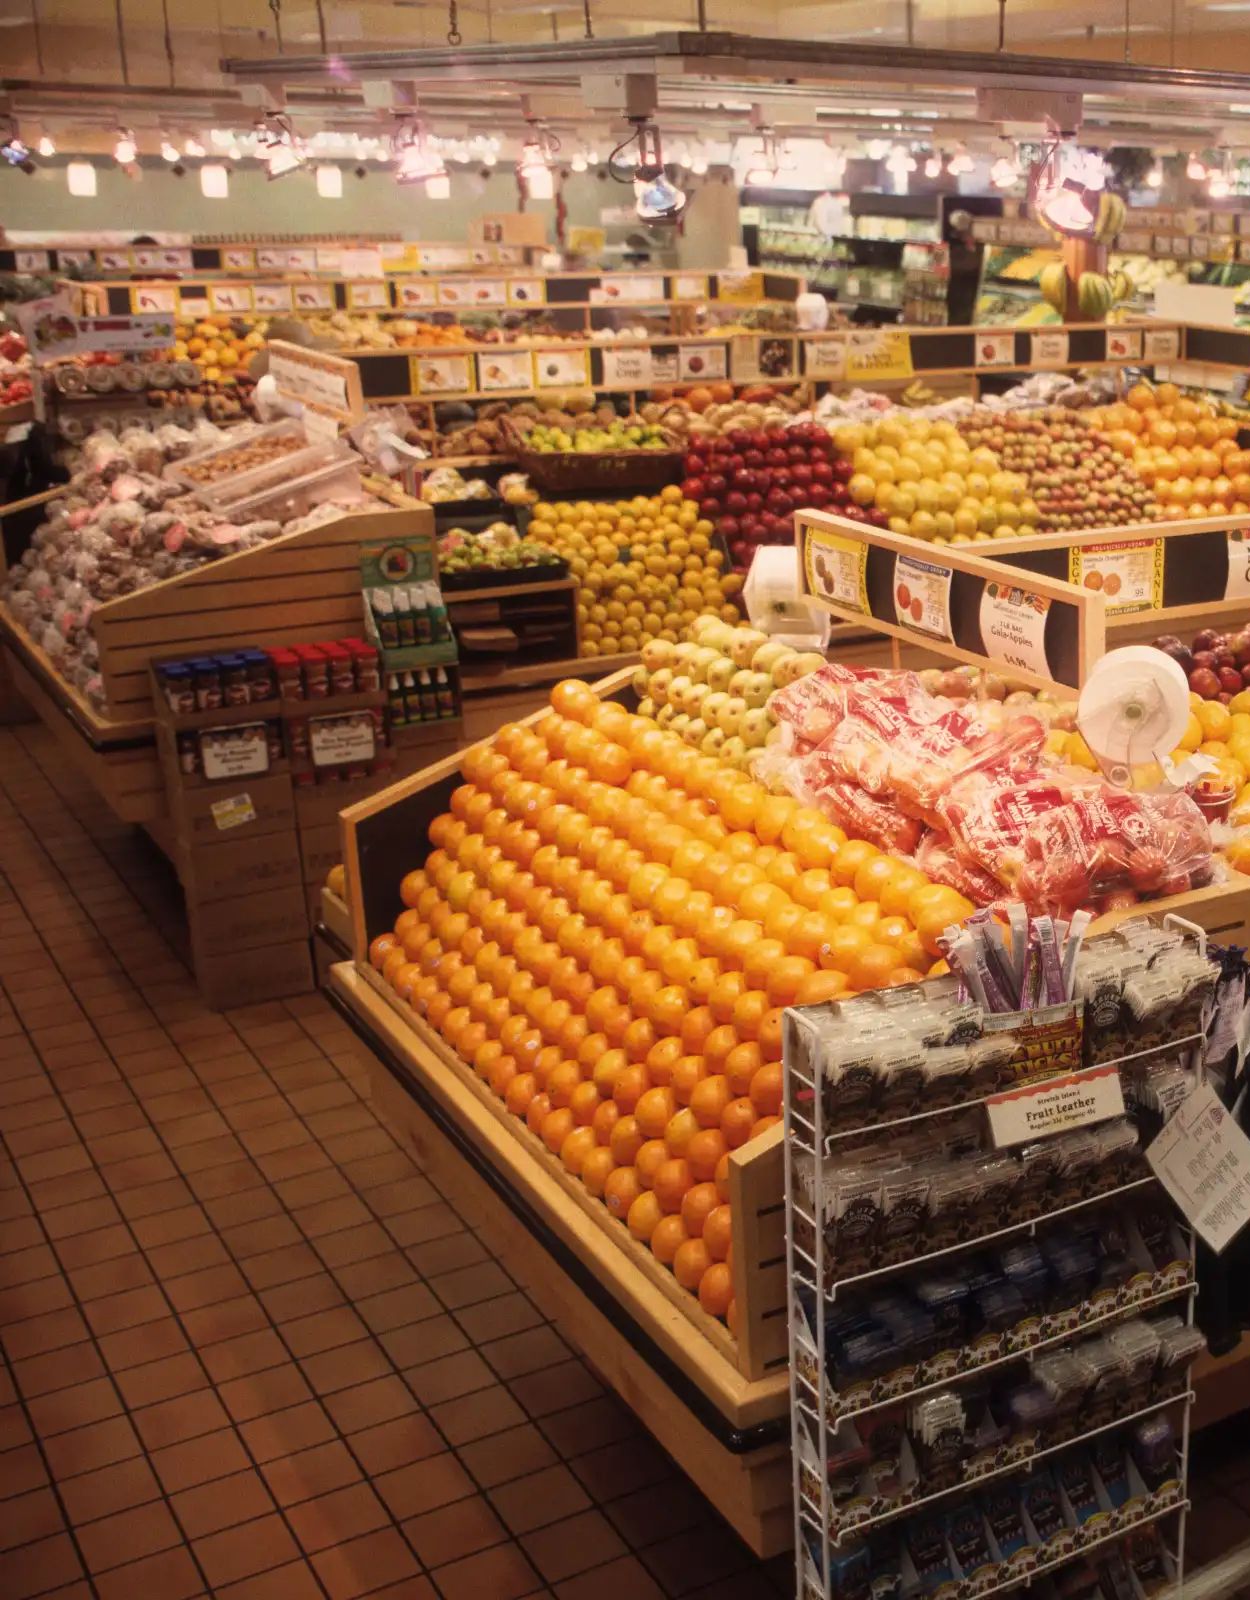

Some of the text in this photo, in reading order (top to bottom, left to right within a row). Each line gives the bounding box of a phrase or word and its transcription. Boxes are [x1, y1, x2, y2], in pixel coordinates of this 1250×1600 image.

[1092, 543, 1126, 552] ORGANICALLY
[1072, 546, 1081, 586] ORGA
[1153, 538, 1163, 609] ORGANIC
[990, 625, 1034, 648] Gala Apples
[1011, 625, 1023, 634] BAG
[1010, 1036, 1075, 1061] FRUIT
[1037, 1089, 1081, 1105] Stretch Island
[1025, 1097, 1096, 1122] Fruit Leather
